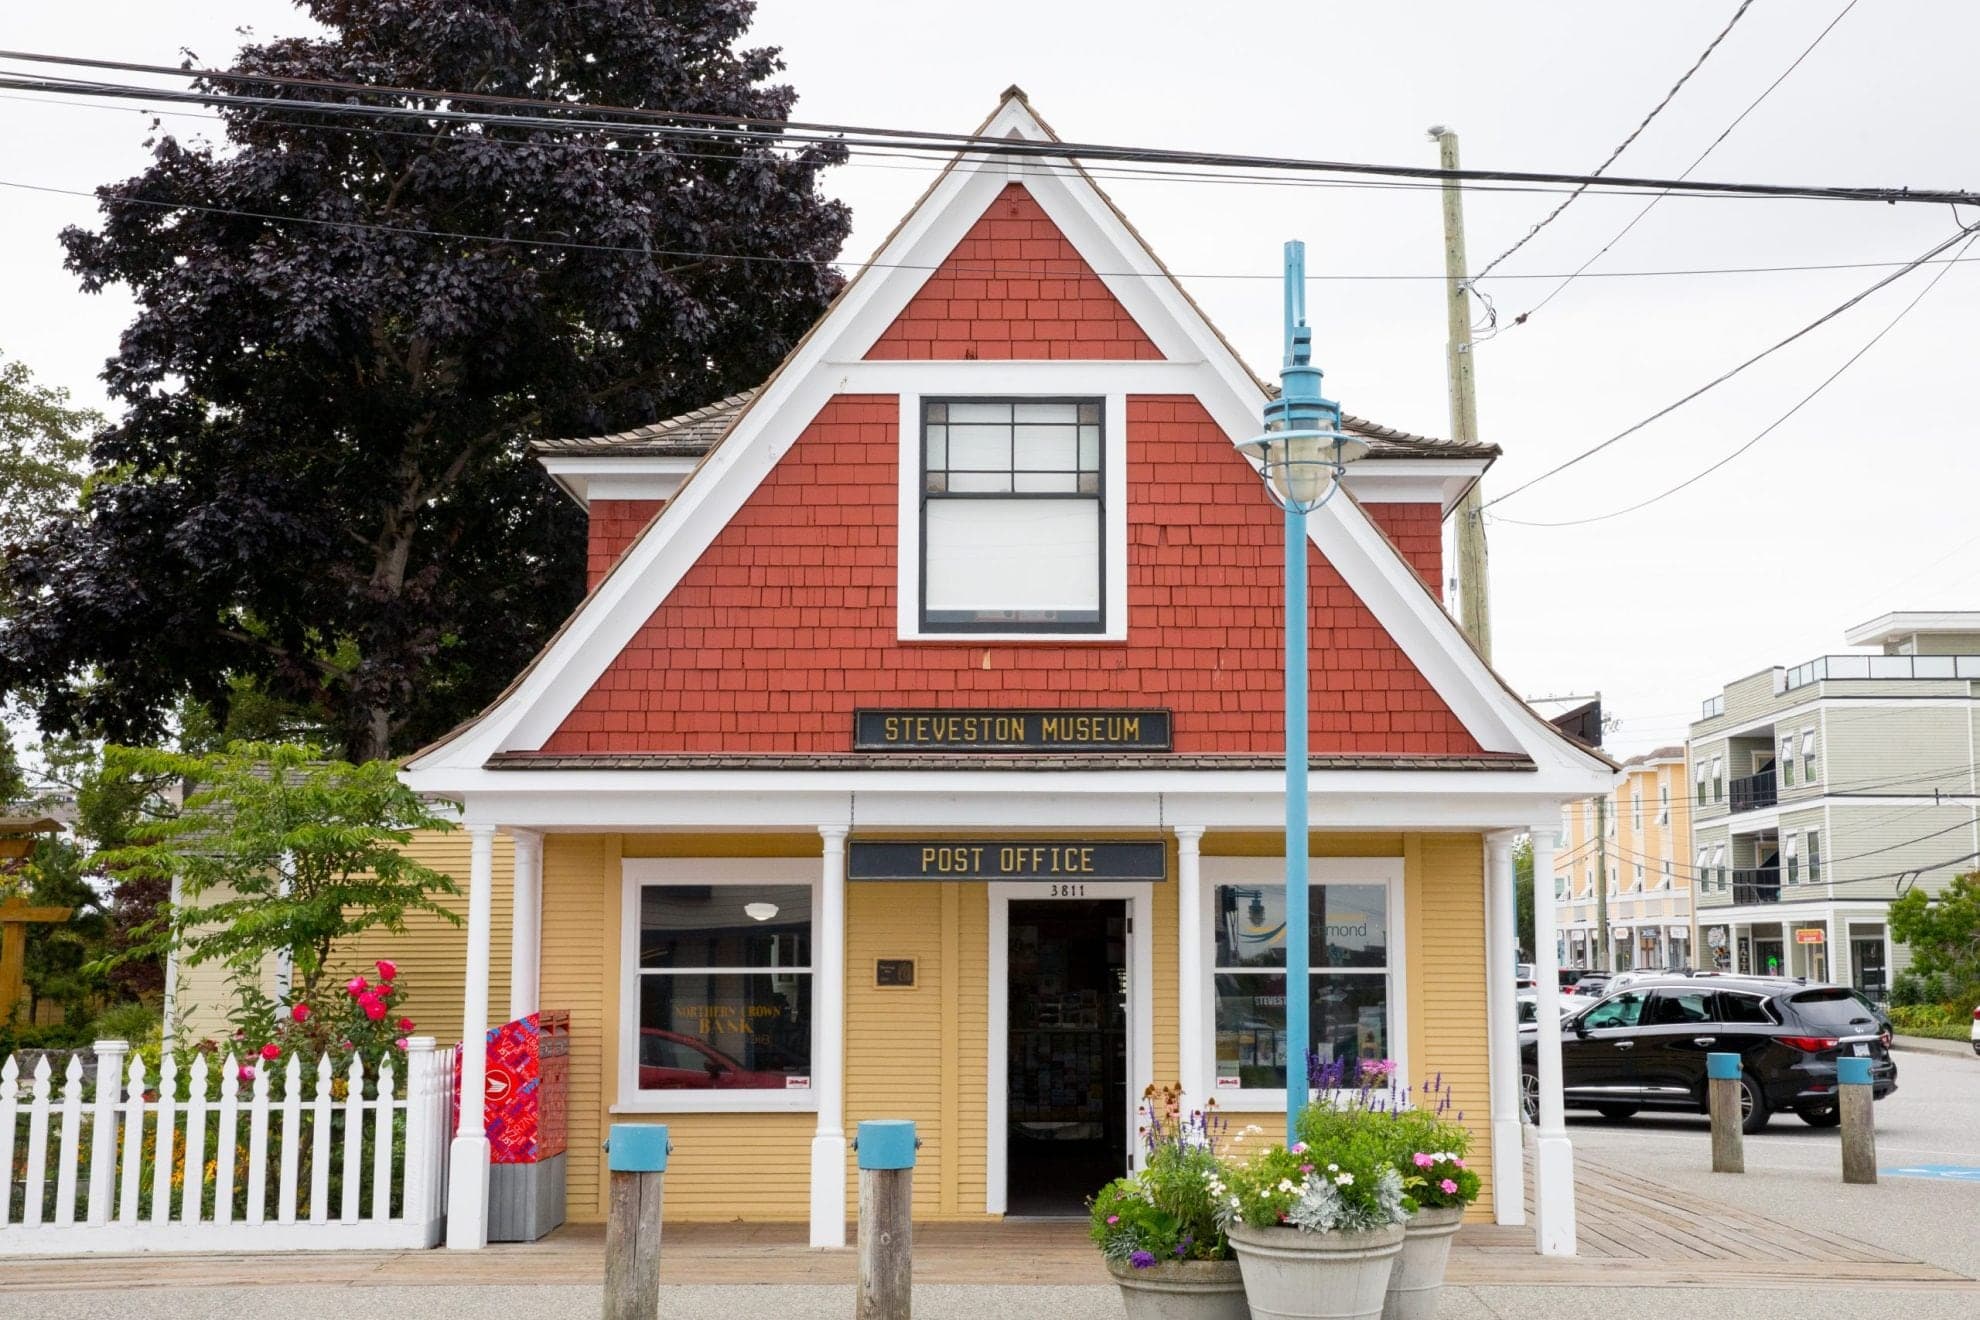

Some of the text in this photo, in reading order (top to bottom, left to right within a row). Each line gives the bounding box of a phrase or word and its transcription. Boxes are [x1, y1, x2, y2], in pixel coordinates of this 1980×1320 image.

[884, 717, 1140, 741] STEVESTON MUSEUM
[922, 847, 1095, 872] POST OFFICE
[1050, 884, 1085, 897] 3811
[1325, 922, 1367, 937] mond
[1254, 995, 1287, 1006] STEVEST
[740, 1005, 781, 1018] CROWN
[700, 1017, 752, 1034] BANK
